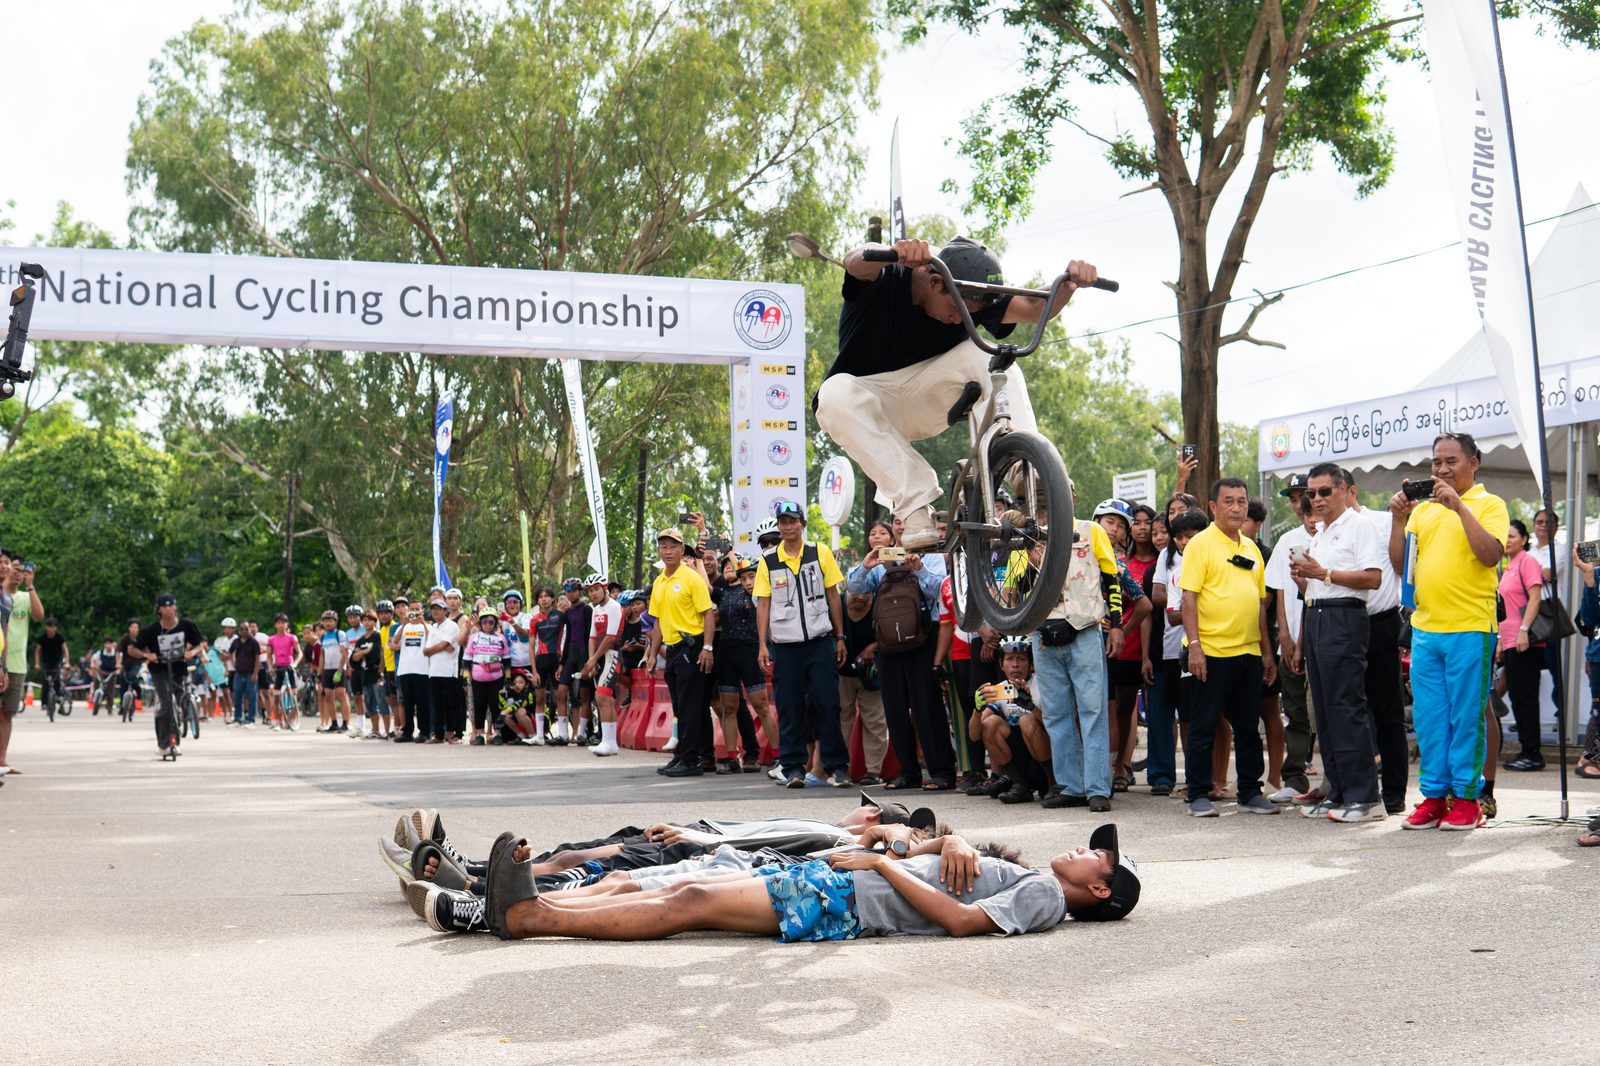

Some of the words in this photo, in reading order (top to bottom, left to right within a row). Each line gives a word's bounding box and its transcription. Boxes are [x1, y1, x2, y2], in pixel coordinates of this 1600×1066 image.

[40, 269, 217, 309] National
[235, 277, 384, 326] Cycling
[399, 284, 679, 337] Championship
[763, 365, 783, 373] MSP
[765, 421, 785, 429] MSP
[766, 478, 786, 486] MSP
